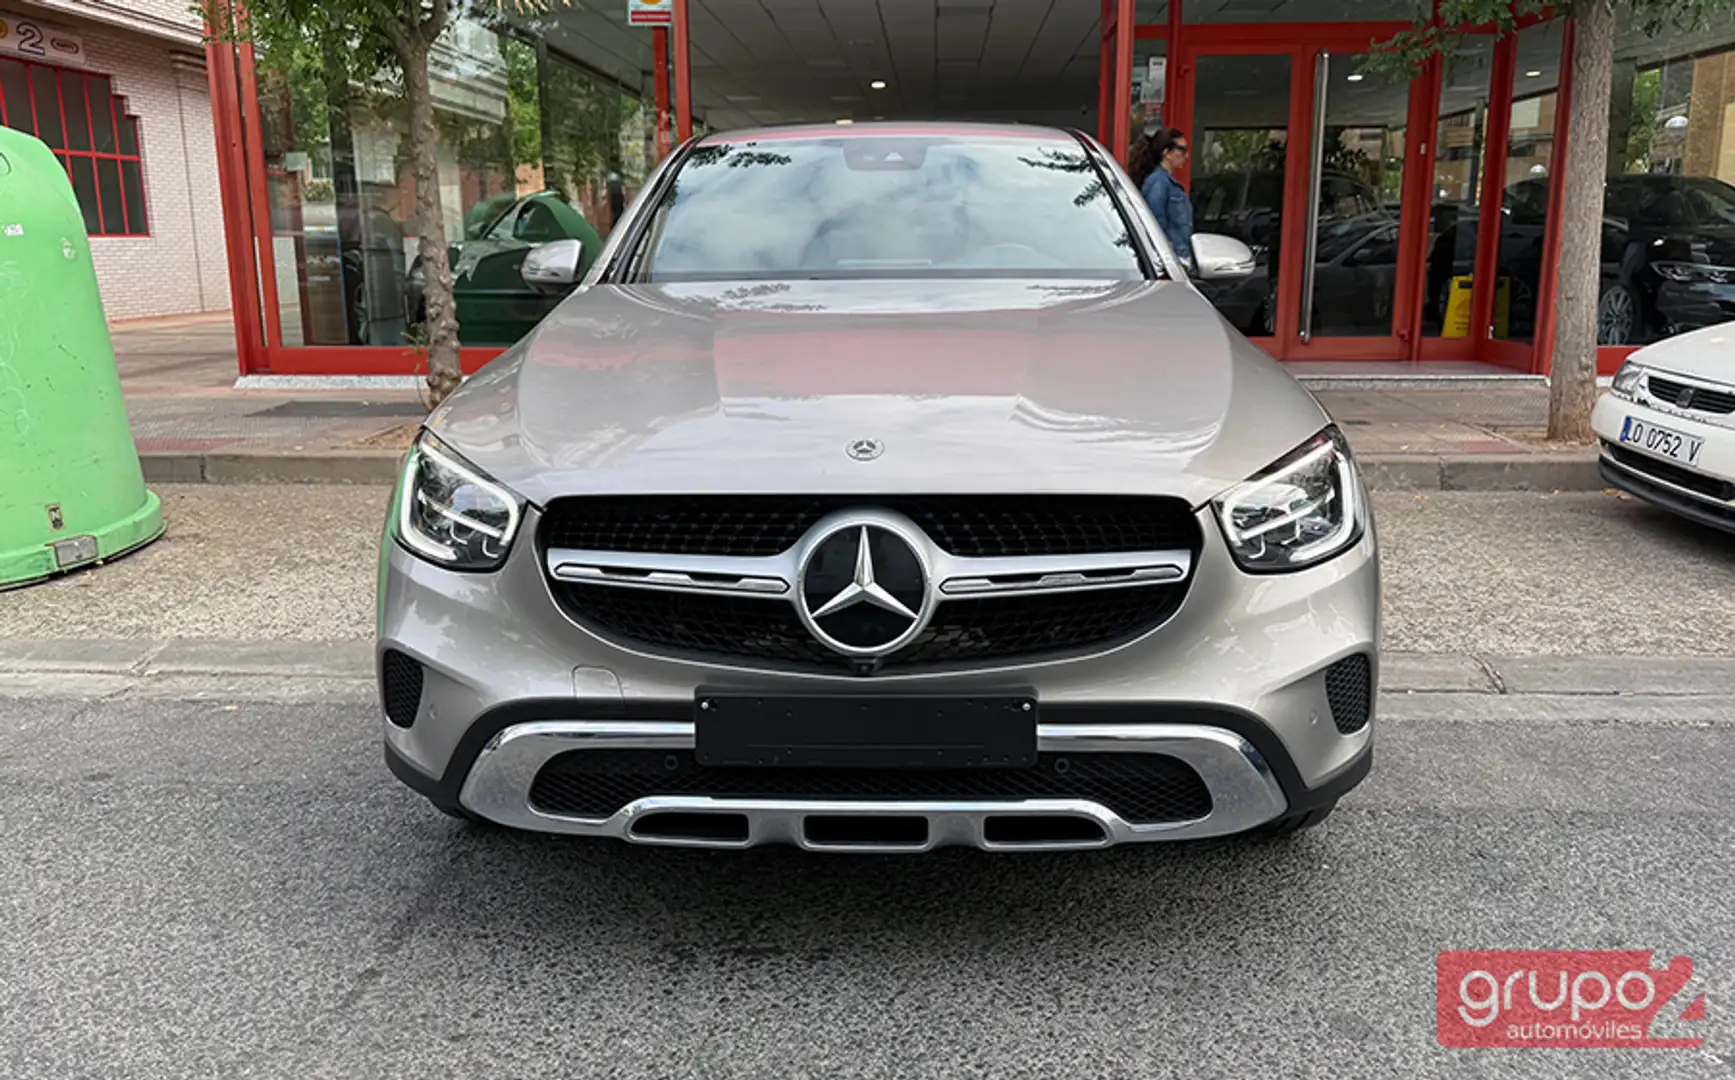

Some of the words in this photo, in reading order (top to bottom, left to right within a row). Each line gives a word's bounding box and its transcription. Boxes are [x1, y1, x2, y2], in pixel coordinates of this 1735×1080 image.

[16, 22, 46, 56] 2
[1646, 428, 1682, 458] 0752
[1688, 440, 1701, 462] V
